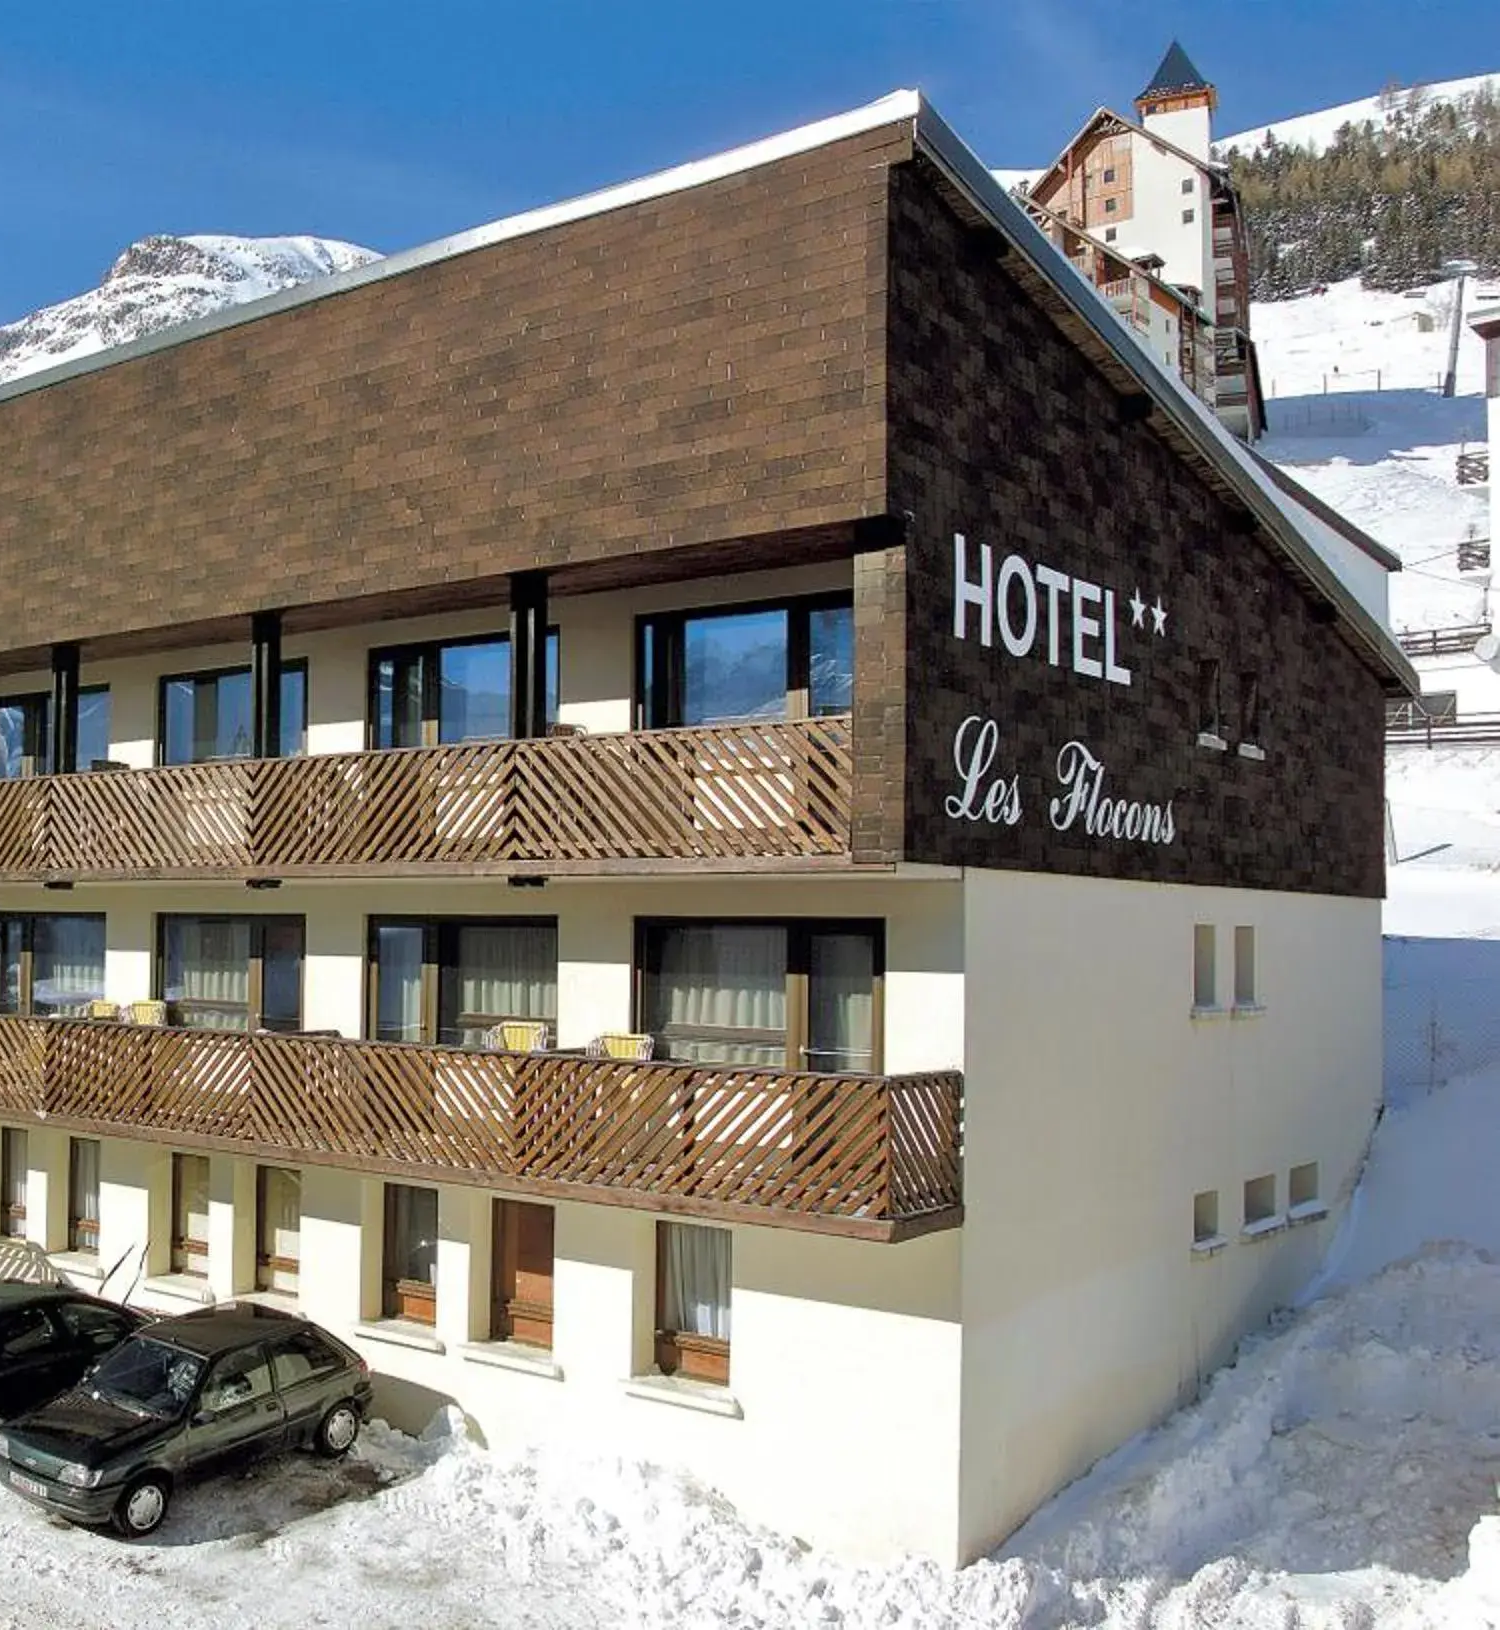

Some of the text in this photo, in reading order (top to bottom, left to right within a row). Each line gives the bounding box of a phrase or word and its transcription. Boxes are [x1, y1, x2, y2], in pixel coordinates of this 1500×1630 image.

[953, 533, 1131, 686] HOTEL
[945, 715, 1176, 845] Les Flocons
